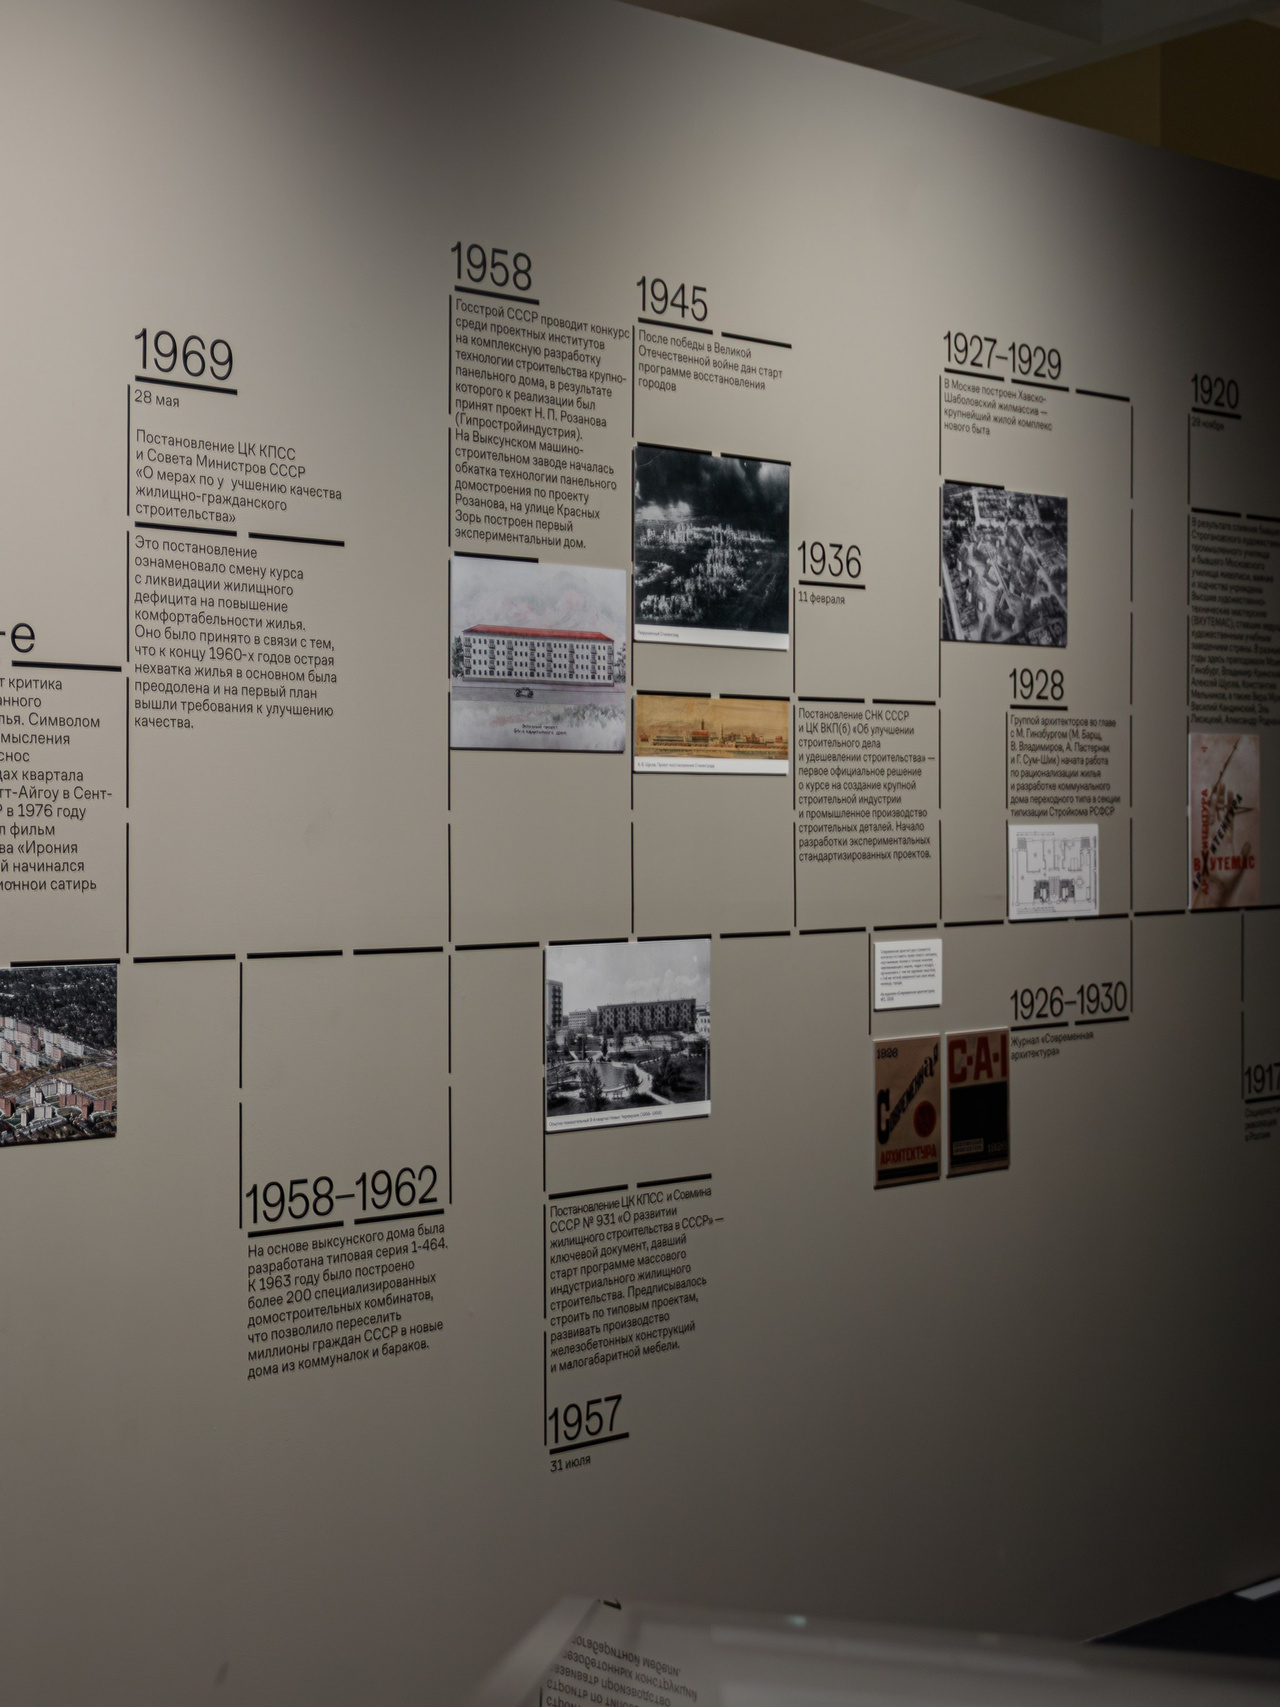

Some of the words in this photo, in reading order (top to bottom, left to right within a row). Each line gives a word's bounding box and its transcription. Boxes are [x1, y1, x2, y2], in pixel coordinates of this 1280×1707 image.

[450, 240, 532, 292] 1958
[636, 275, 708, 322] 1945
[455, 318, 488, 332] среди
[490, 323, 546, 341] проектных
[548, 333, 605, 350] институтов
[456, 298, 504, 318] Госстрой
[507, 307, 539, 323] СССР
[541, 315, 588, 332] проводит
[590, 324, 630, 340] конкурс
[134, 328, 234, 381] 1969
[455, 334, 468, 345] на
[471, 336, 542, 357] комплексную
[544, 348, 601, 368] разработку
[639, 329, 668, 345] После
[670, 336, 705, 352] победы
[707, 343, 712, 352] в
[714, 341, 752, 358] Великой
[455, 350, 514, 367] технологии
[515, 359, 587, 378] строительства
[589, 371, 627, 384] крупно-
[638, 344, 711, 366] Отечественной
[713, 359, 739, 372] войне
[740, 364, 757, 375] дан
[758, 367, 783, 380] старт
[638, 362, 691, 379] программе
[693, 371, 766, 390] восстановления
[134, 389, 152, 404] 28
[156, 393, 180, 409] мая
[638, 378, 677, 392] городов
[1191, 373, 1240, 410] 1920
[136, 428, 235, 454] Постановление
[238, 441, 256, 458] ЦК
[259, 444, 296, 461] КПСС
[136, 450, 144, 460] и
[147, 448, 193, 466] Совета
[196, 454, 266, 476] Министров
[269, 462, 306, 478] СССР
[797, 540, 862, 579] 1936
[798, 590, 808, 602] 11
[809, 592, 846, 605] февраля
[8, 678, 62, 692] критика
[1009, 668, 1064, 701] 1928
[28, 712, 100, 728] Символом
[798, 707, 863, 720] Постановление
[864, 709, 883, 721] СНК
[885, 710, 910, 721] СССР
[798, 725, 804, 733] и
[806, 722, 819, 735] ЦК
[820, 722, 851, 736] ВКП(б)
[852, 723, 869, 734] «Об
[870, 726, 915, 737] улучшении
[798, 738, 861, 750] строительного
[861, 740, 881, 750] дела
[880, 1143, 937, 1166] АРХИТЕКТУРА
[550, 1200, 620, 1218] Постановление
[621, 1195, 635, 1209] ЦК
[636, 1191, 664, 1206] КПСС
[666, 1193, 673, 1202] и
[673, 1187, 712, 1201] Совмина
[248, 1244, 264, 1258] На
[267, 1241, 309, 1256] основе
[312, 1231, 384, 1250] выксунского
[386, 1227, 415, 1242] дома
[417, 1223, 445, 1236] была
[550, 1246, 599, 1264] ключевой
[600, 1241, 649, 1259] документ,
[650, 1233, 687, 1251] давший
[248, 1256, 324, 1278] разработана
[326, 1249, 373, 1264] типовая
[375, 1245, 409, 1259] серия
[411, 1237, 448, 1253] 1-464.
[548, 1394, 622, 1444] 1957
[550, 1460, 564, 1472] 31
[565, 1454, 591, 1470] июля
